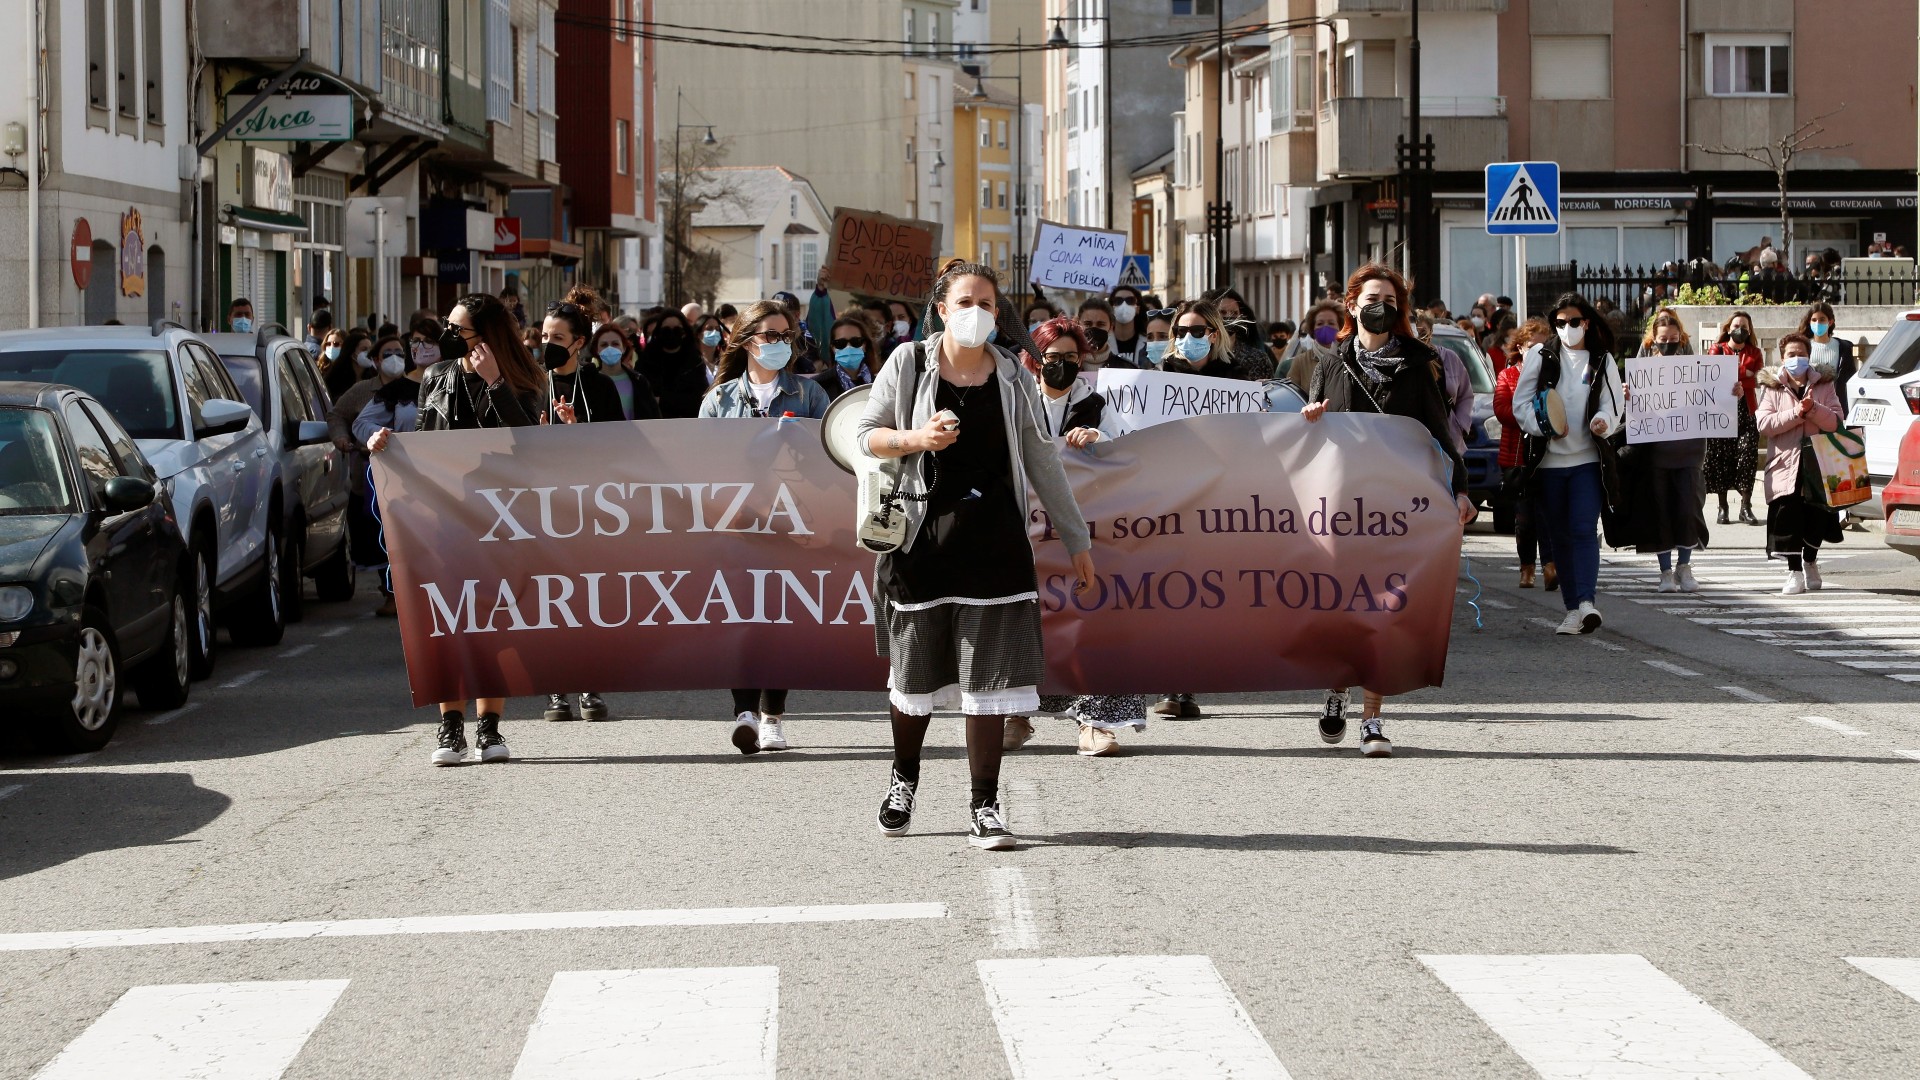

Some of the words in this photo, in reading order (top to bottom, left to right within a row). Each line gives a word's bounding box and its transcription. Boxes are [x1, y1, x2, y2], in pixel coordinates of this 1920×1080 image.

[257, 78, 320, 90] RGALO
[235, 106, 315, 135] Arca
[1560, 200, 1600, 210] RVEXARÍA
[1614, 198, 1672, 209] NORDESÍA
[1771, 199, 1816, 208] CAETARÍA
[1830, 199, 1882, 208] CERVEXARÍA
[842, 217, 911, 248] ONDE
[1053, 232, 1064, 244] A
[1049, 249, 1082, 264] CONA
[1093, 256, 1118, 268] NON
[1628, 367, 1653, 390] NON
[1106, 384, 1149, 414] NON
[1161, 384, 1262, 416] PARAREMOS
[1631, 391, 1677, 413] PORQUE
[1685, 387, 1716, 407] NON
[1629, 418, 1654, 436] SAE
[1656, 417, 1665, 434] O
[1667, 415, 1689, 432] TEU
[474, 482, 815, 542] XUSTIZA
[1112, 511, 1182, 540] son
[1196, 495, 1298, 534] unha
[1308, 497, 1430, 537] delas”
[419, 569, 876, 637] MARUXAINA
[1043, 570, 1226, 612] SOMOS
[1238, 569, 1408, 612] TODAS
